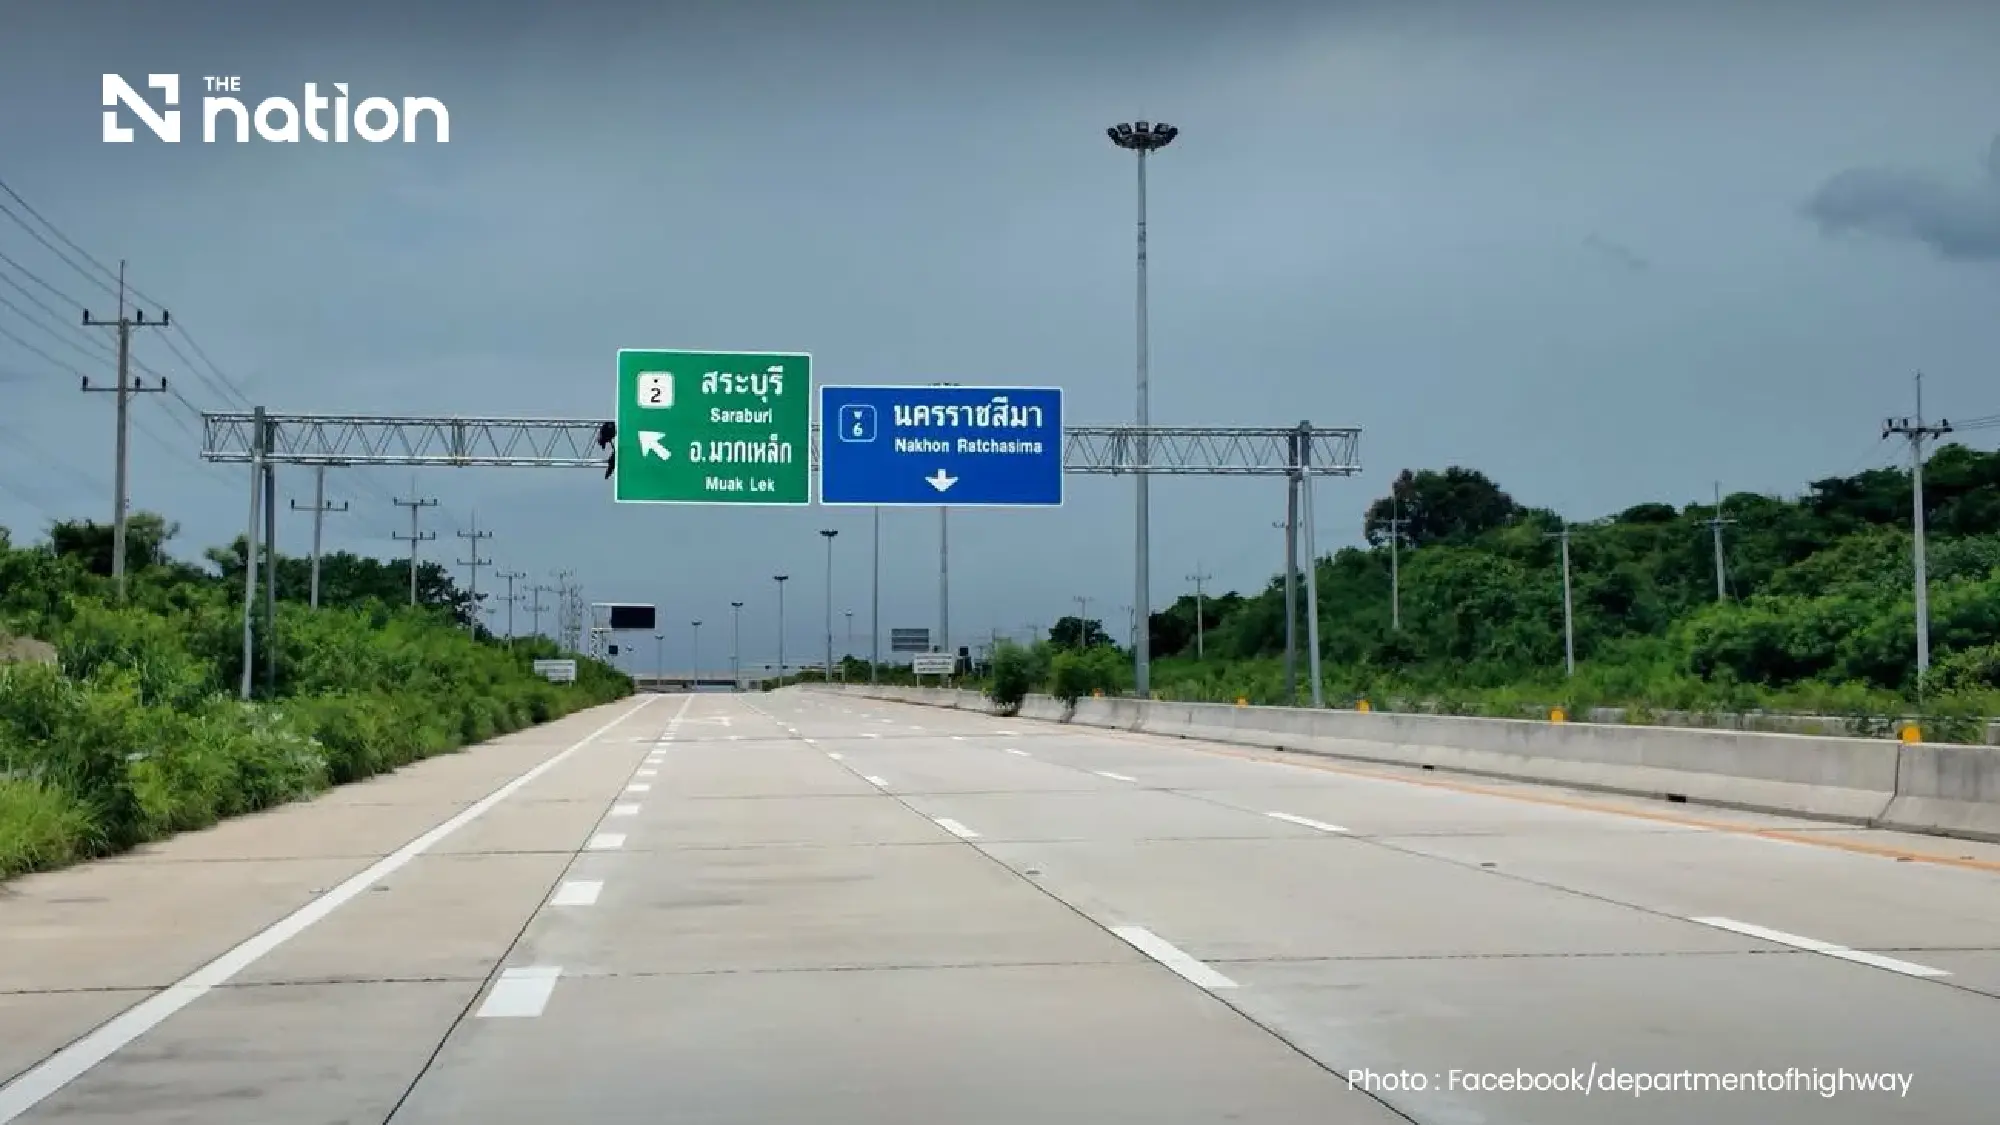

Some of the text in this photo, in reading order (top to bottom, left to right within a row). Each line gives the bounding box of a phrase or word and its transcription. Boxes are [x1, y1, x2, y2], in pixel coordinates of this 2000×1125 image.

[701, 365, 784, 404] สระบุรี
[650, 387, 661, 404] 2
[710, 407, 773, 424] Saraburi
[893, 396, 1043, 427] นครราชสีมา
[853, 422, 864, 437] 6
[689, 433, 793, 463] อ.มวกเหล็ก
[894, 437, 1043, 453] Nakhon Ratchasima
[705, 476, 775, 492] Muak Lek
